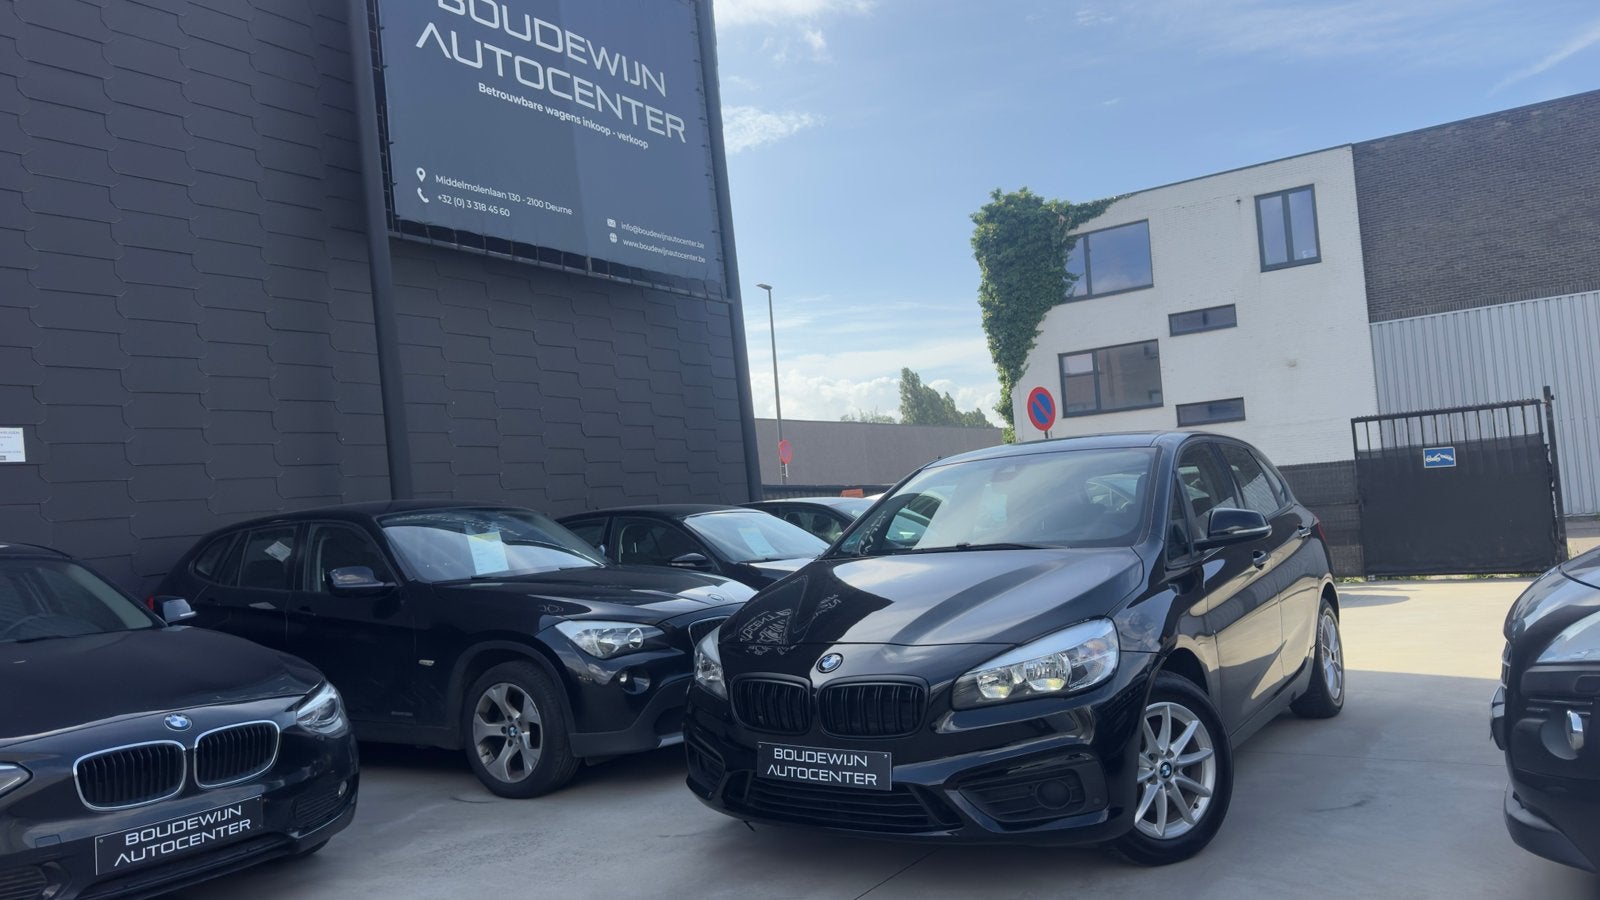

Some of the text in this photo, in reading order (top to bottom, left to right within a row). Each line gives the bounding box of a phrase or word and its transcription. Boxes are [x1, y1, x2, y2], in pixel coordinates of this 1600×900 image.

[416, 22, 686, 143] AUTOCENTER
[478, 82, 544, 112] Betrouwbare
[545, 105, 581, 125] wagens
[582, 116, 611, 136] inkoop
[617, 131, 648, 149] verkoop
[435, 174, 507, 200] Middelmolenlaan
[507, 192, 521, 203] 130
[526, 196, 544, 208] 2100
[545, 201, 573, 215] Deurne
[438, 194, 511, 217] +32 (0) 3 318 45 60
[767, 764, 877, 785] AUTOCENTER
[774, 747, 868, 767] BOUDEWIJN
[114, 819, 251, 866] AUTOCENTER
[125, 805, 242, 846] BOUDEWIJN
